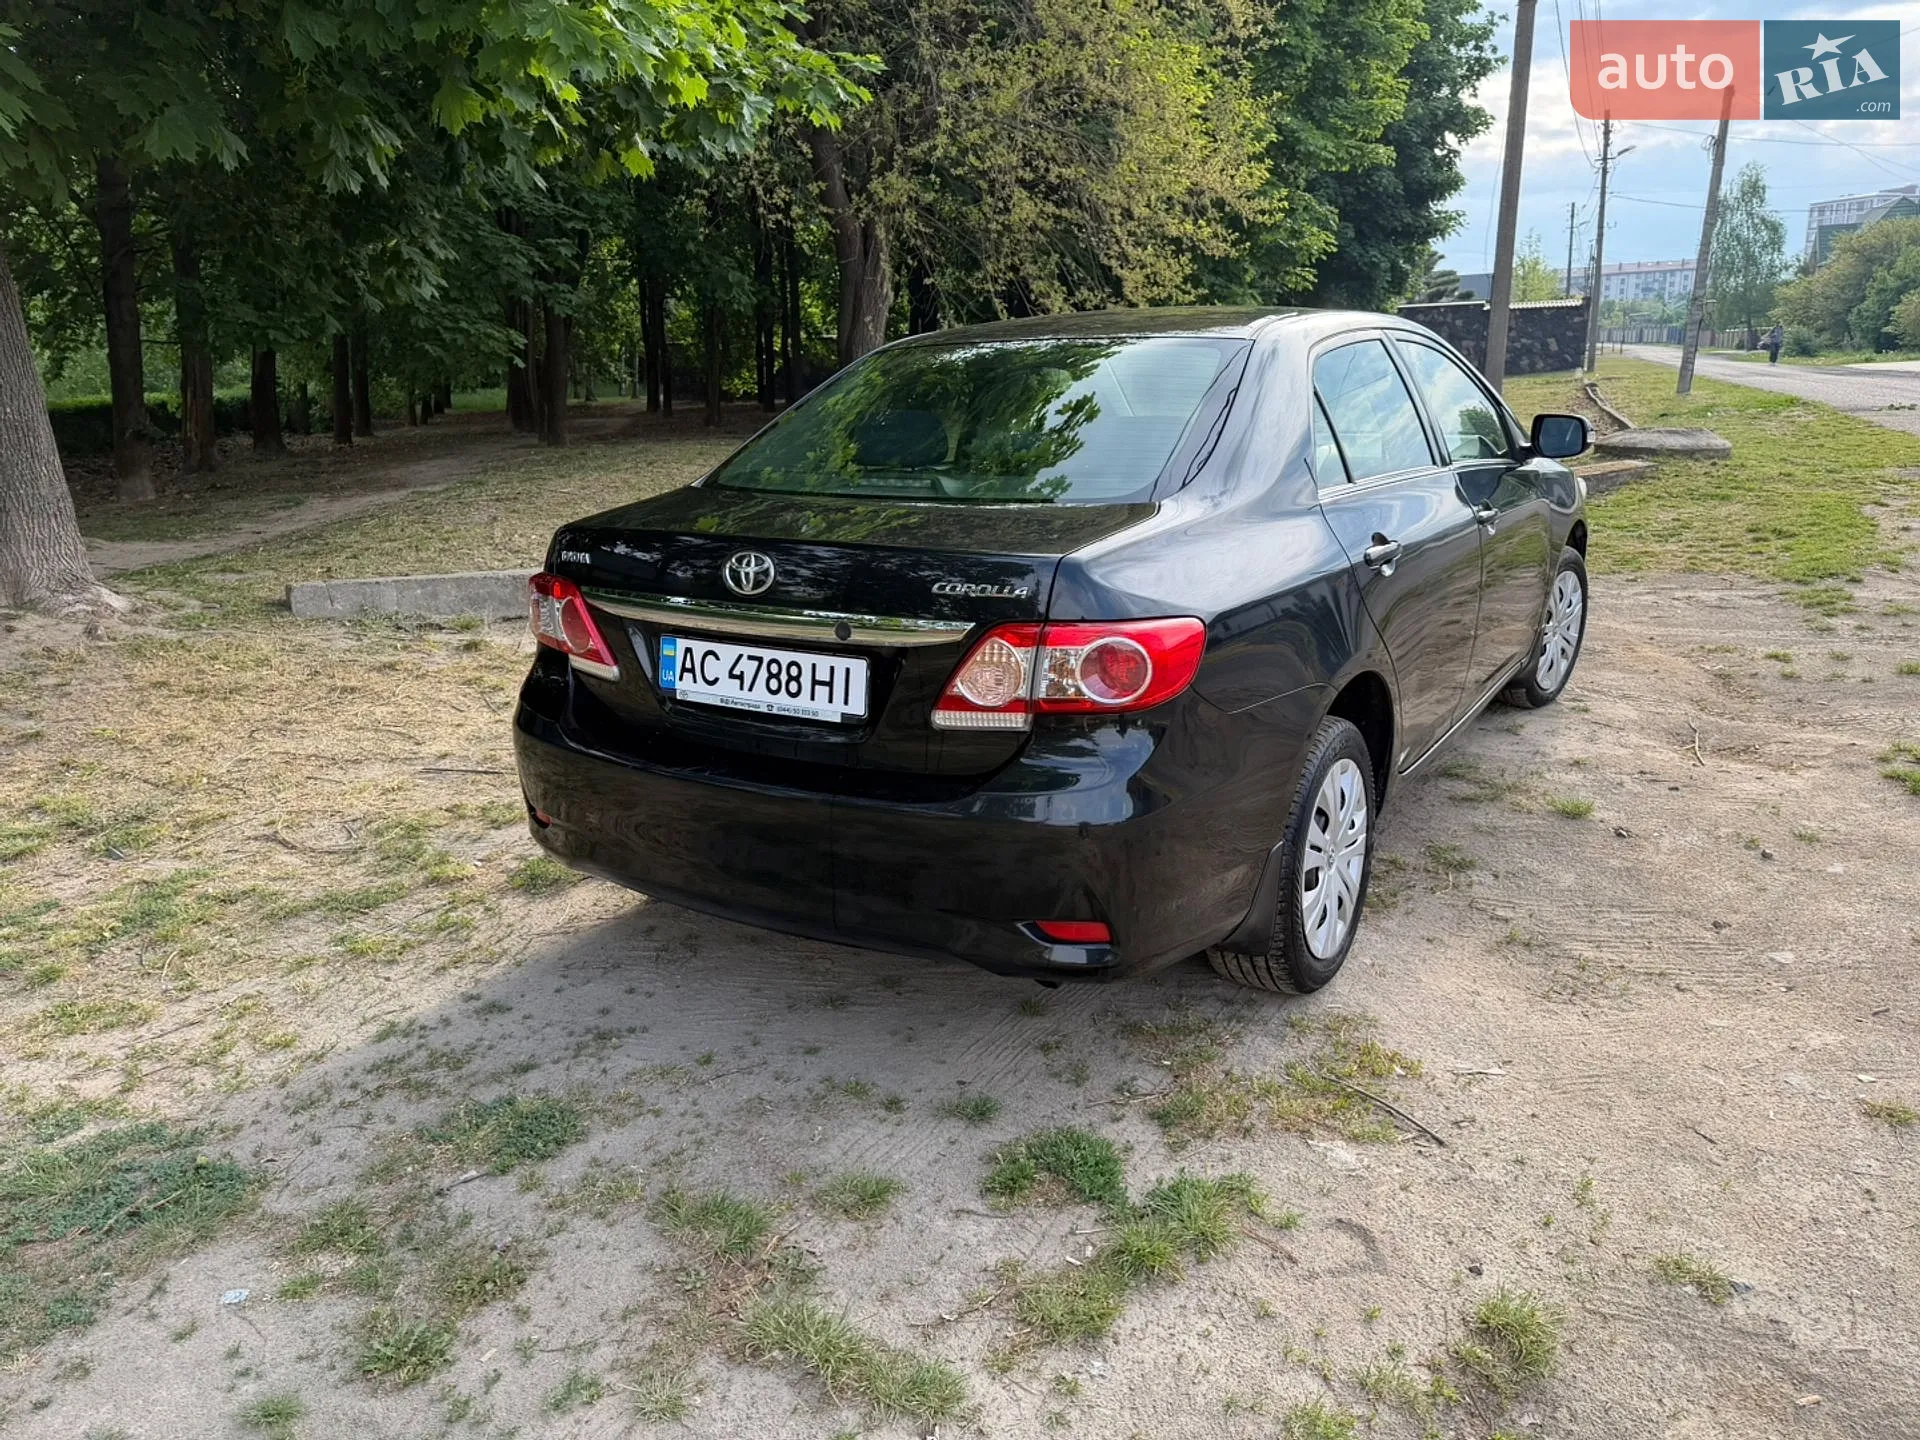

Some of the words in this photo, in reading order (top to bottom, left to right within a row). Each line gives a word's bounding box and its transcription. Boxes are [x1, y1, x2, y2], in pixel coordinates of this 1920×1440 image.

[931, 581, 1029, 599] COROLLA
[662, 668, 675, 682] UA
[678, 646, 721, 687] AC
[728, 653, 802, 699] 4788
[810, 662, 851, 706] HI
